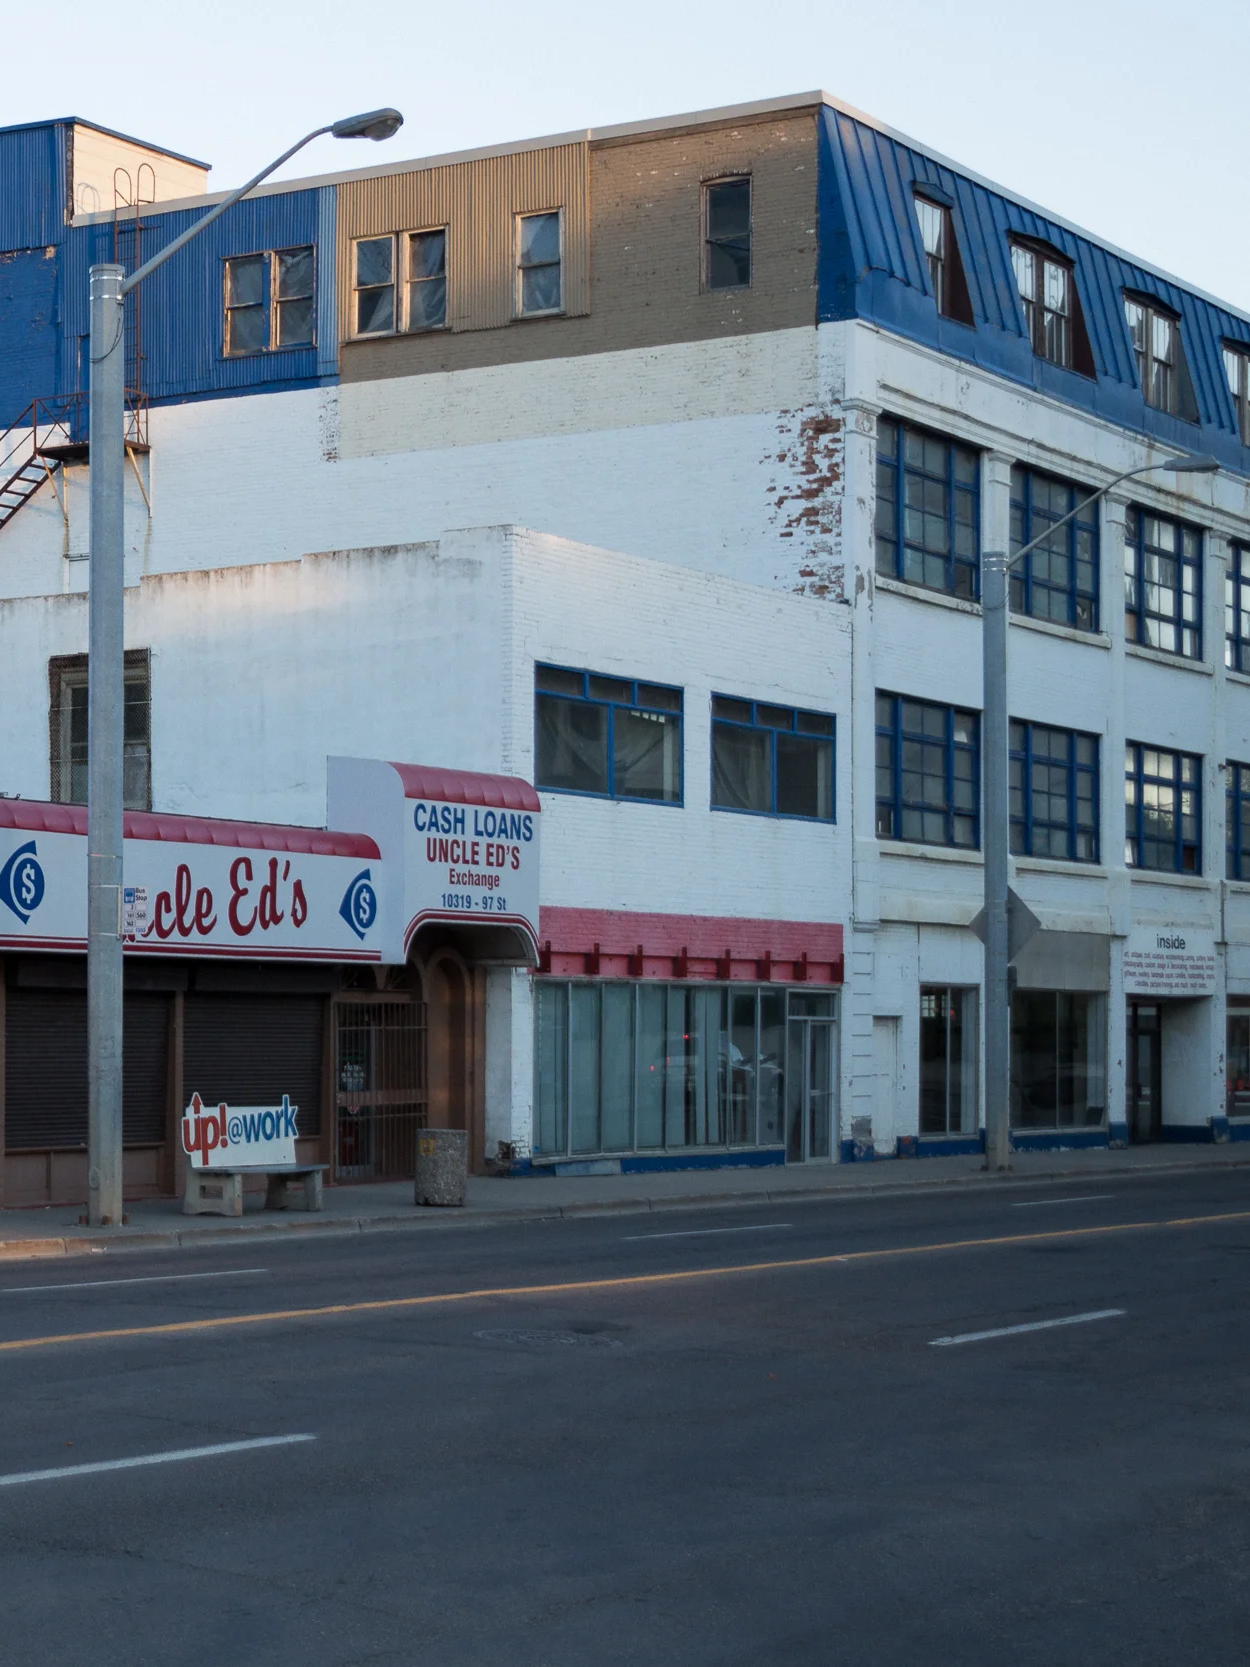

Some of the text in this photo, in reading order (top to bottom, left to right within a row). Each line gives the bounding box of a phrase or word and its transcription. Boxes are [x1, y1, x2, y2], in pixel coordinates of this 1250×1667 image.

[413, 803, 533, 842] CASH LOANS
[426, 837, 520, 870] UNCLE ED'S
[449, 868, 500, 890] Exchange
[122, 857, 308, 942] cle Ed's
[441, 893, 471, 909] 10319
[482, 896, 493, 910] 97
[497, 897, 506, 911] St
[1157, 933, 1186, 949] inside
